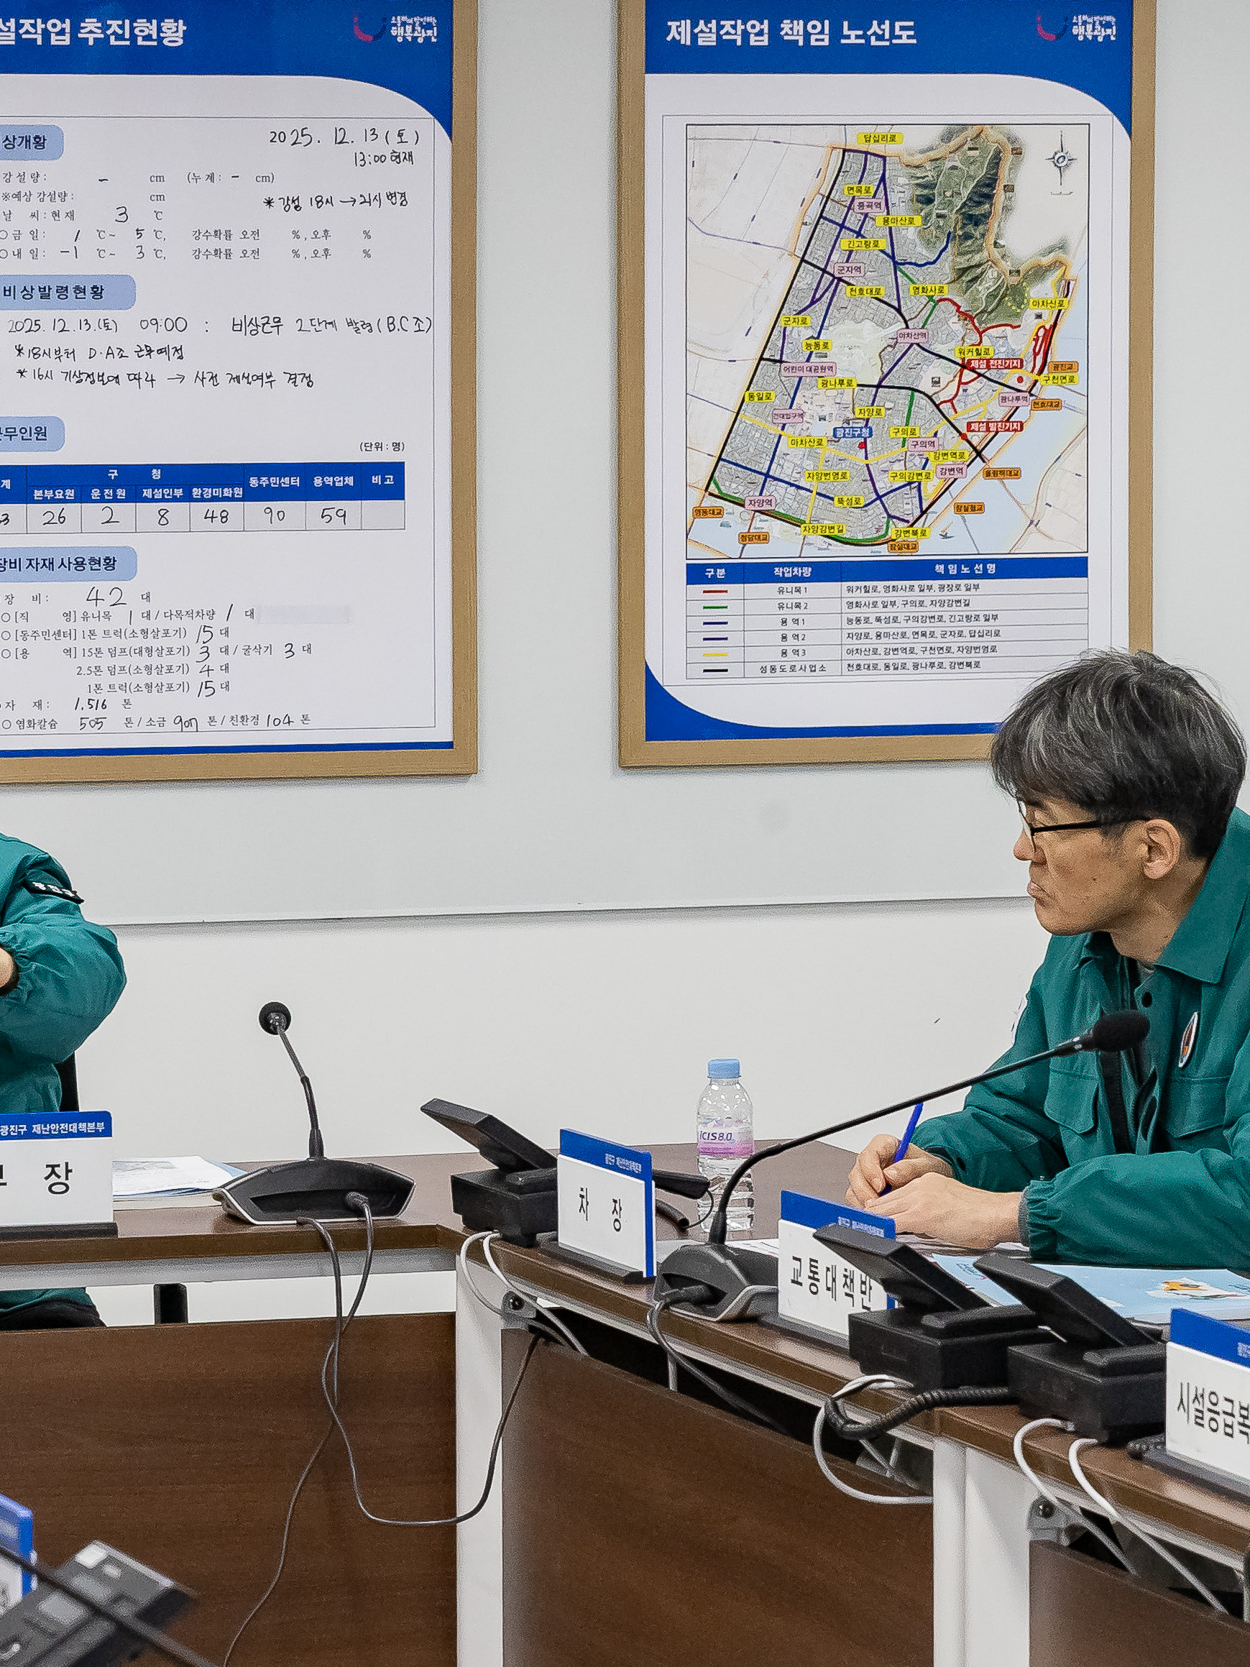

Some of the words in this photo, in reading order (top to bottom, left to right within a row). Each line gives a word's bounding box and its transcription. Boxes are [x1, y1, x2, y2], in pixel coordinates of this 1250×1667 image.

[78, 19, 187, 46] 추진현황
[391, 25, 437, 43] 행복광진
[666, 19, 768, 45] 제설작업
[780, 20, 829, 46] 책임
[841, 20, 917, 45] 노선도
[864, 131, 896, 144] 답십리로
[115, 206, 128, 223] 3
[193, 229, 233, 241] 강수확률
[240, 229, 259, 240] 오전
[837, 263, 863, 277] 군자역
[4, 285, 104, 300] 비상발령현황
[140, 317, 187, 333] 09:00
[232, 315, 283, 336] 비상근무
[296, 318, 337, 332] 2단계
[781, 314, 809, 328] 군자로
[194, 371, 219, 387] 사전
[283, 372, 313, 388] 결정
[856, 406, 884, 419] 자양로
[890, 425, 918, 438] 구의로
[911, 441, 935, 449] 구의역
[249, 477, 299, 487] 동주민센터
[313, 476, 353, 487] 용역업체
[34, 489, 74, 500] 본부요원
[143, 488, 183, 498] 제설인부
[193, 487, 242, 498] 환경미화원
[746, 496, 775, 507] 자양역
[43, 508, 65, 525] 26
[101, 506, 119, 524] 2
[158, 509, 169, 526] 8
[204, 509, 229, 523] 48
[264, 507, 285, 524] 90
[321, 507, 346, 525] 59
[26, 558, 54, 571] 자재
[58, 556, 117, 571] 사용현황
[774, 567, 811, 577] 작업차량
[86, 587, 126, 607] 42
[81, 610, 111, 622] 유니목
[164, 609, 215, 620] 다목적차량
[196, 625, 213, 644] 15
[196, 646, 210, 665] 3
[242, 644, 272, 656] 굴삭기
[285, 643, 295, 658] 3
[197, 662, 214, 677] 4
[198, 681, 215, 697] 15
[16, 718, 58, 730] 염화칼슘
[80, 717, 107, 730] 505
[146, 717, 166, 727] 소금
[230, 714, 259, 726] 친환경
[267, 714, 294, 727] 104
[0, 1125, 27, 1136] 광진구
[32, 1122, 104, 1134] 재난안전대책본부
[791, 1256, 872, 1311] 교통대책반
